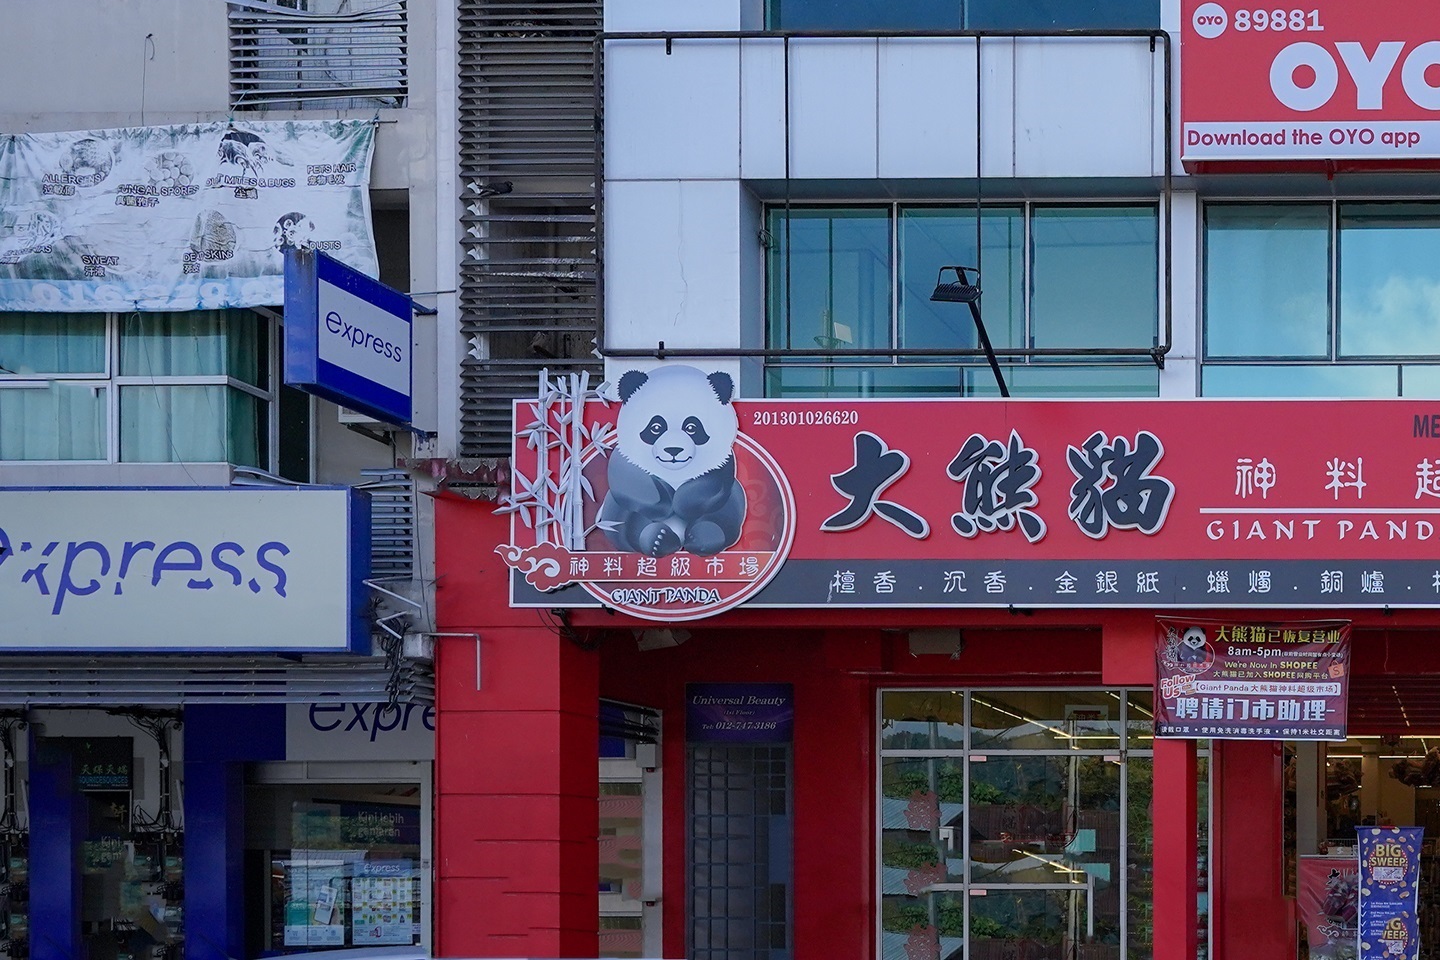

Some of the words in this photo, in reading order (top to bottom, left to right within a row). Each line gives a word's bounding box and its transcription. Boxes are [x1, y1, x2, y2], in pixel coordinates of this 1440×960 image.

[1234, 9, 1324, 32] 89881
[1188, 129, 1287, 147] Download
[1291, 129, 1323, 146] the
[1328, 129, 1375, 146] OYO
[1381, 132, 1421, 150] app
[307, 164, 332, 174] PETS
[224, 175, 257, 186] MITES
[258, 178, 267, 187] &
[268, 178, 296, 187] BUGS
[81, 255, 119, 266] SWEAT
[325, 310, 403, 363] express
[753, 410, 858, 426] 201301026620
[819, 428, 1177, 544] 大熊貓
[1206, 519, 1321, 541] GIANT
[0, 526, 290, 615] xpress
[568, 555, 761, 578] 神料超級市場
[832, 570, 898, 596] 檀香
[943, 570, 1008, 595] 沉香
[1054, 570, 1160, 595] 金銀紙
[1319, 570, 1384, 595] 銅爐
[611, 589, 662, 606] GIANT
[661, 589, 722, 605] PANDA
[1214, 625, 1340, 645] 大熊猫已恢复营业
[1228, 646, 1282, 659] 8am-5pm
[1225, 661, 1248, 669] We're
[1280, 661, 1318, 670] SHOPEE
[1160, 675, 1195, 689] Follow
[1223, 684, 1249, 692] Panda
[1162, 687, 1181, 699] Us
[692, 695, 745, 705] Universal
[747, 695, 786, 706] Beauty
[1376, 844, 1401, 857] BIG
[364, 862, 400, 874] express
[1371, 857, 1406, 867] SWEEP
